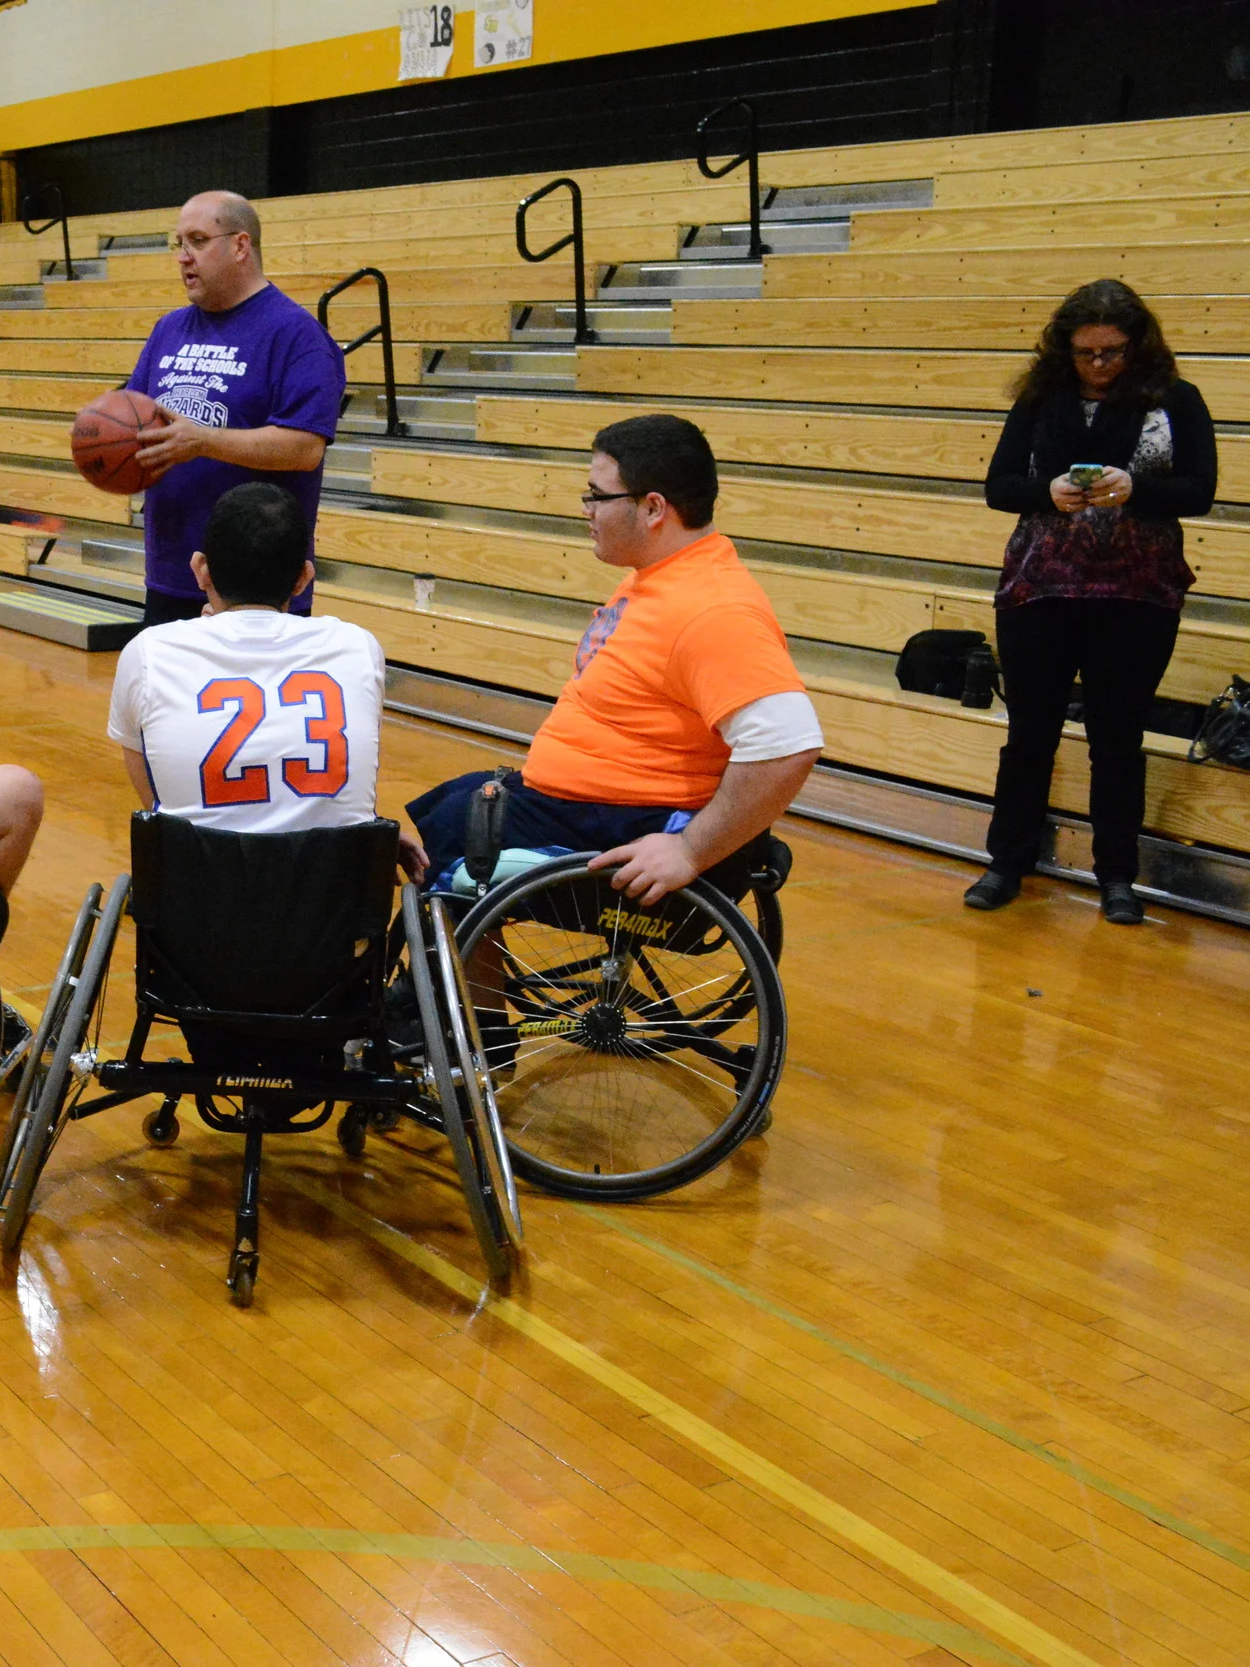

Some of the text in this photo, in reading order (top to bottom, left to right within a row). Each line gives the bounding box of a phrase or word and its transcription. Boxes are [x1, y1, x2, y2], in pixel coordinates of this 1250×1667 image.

[430, 4, 453, 47] 18
[177, 344, 239, 360] A BATTLE
[159, 355, 248, 376] OF THE SCHOOLS
[158, 372, 229, 393] Against The
[197, 670, 349, 809] 23
